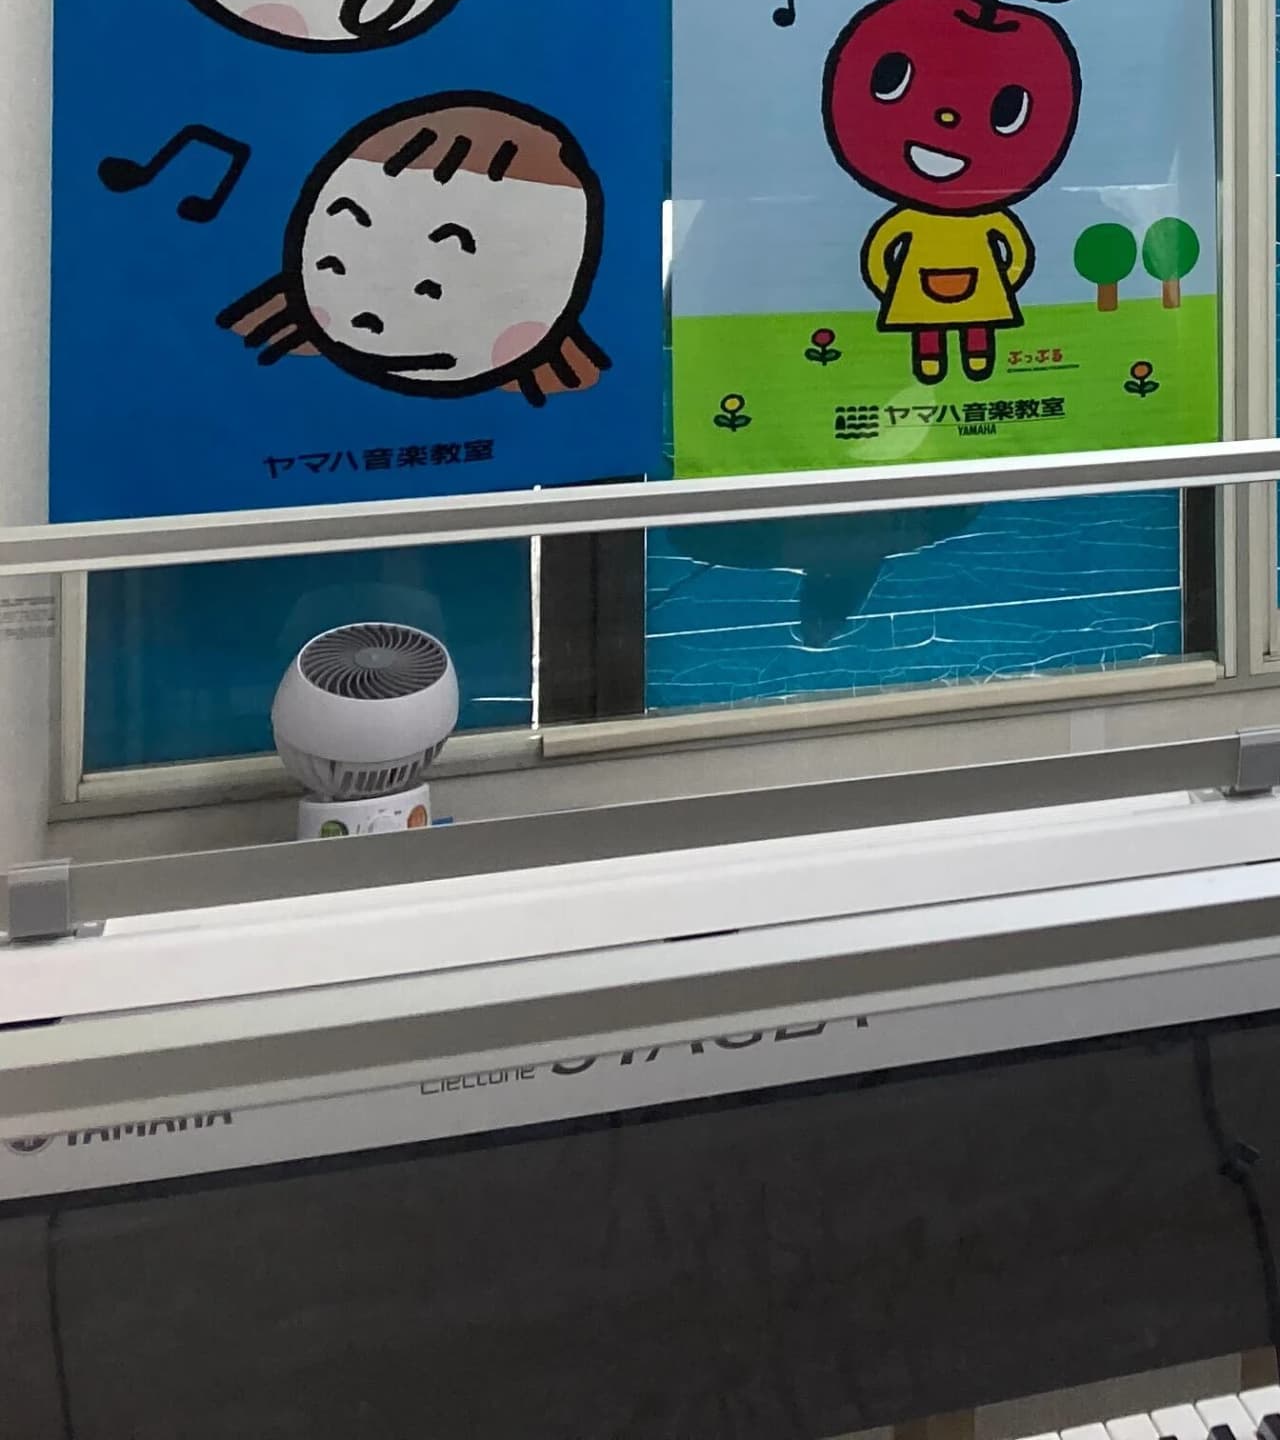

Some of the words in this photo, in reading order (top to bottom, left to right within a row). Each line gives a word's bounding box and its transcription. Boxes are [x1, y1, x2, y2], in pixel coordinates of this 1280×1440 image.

[883, 396, 1066, 425] ヤマハ音楽教室
[957, 424, 997, 436] YAMAHA
[263, 438, 496, 479] ヤマハ音楽教室
